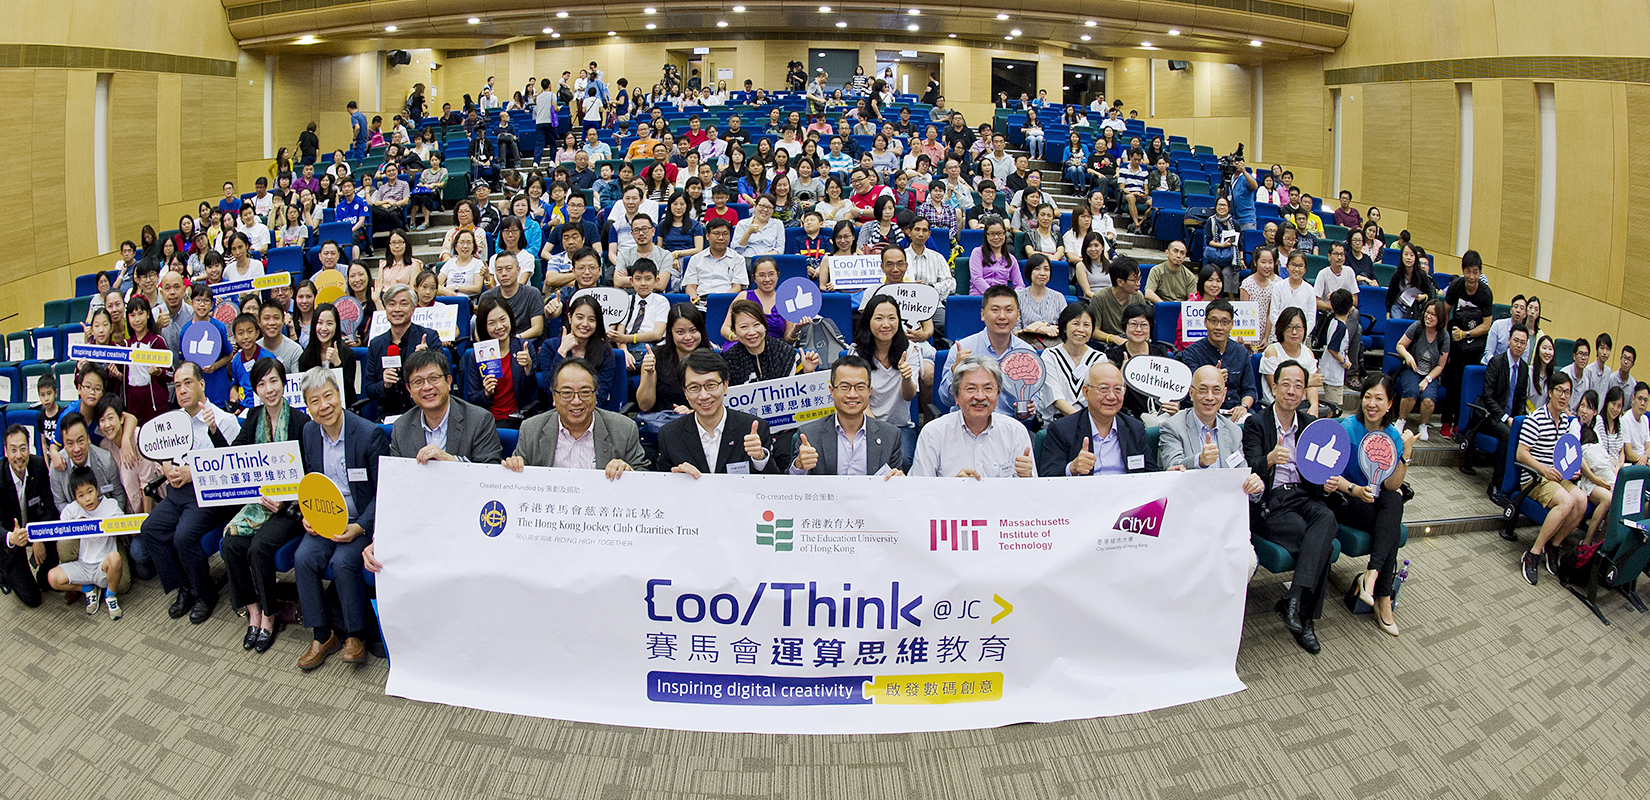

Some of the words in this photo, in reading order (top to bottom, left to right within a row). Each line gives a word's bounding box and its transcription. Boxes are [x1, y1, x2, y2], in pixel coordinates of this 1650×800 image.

[897, 286, 908, 297] im
[911, 290, 916, 298] a
[74, 348, 91, 357] Inspiring
[1150, 359, 1161, 372] im
[1164, 366, 1170, 374] a
[1130, 372, 1185, 393] coolthinker
[154, 421, 165, 433] im
[166, 421, 172, 430] a
[144, 434, 189, 452] coolthinker
[480, 482, 502, 490] Created
[537, 485, 545, 493] by
[222, 490, 236, 498] digital
[756, 492, 793, 500] Co-created
[795, 493, 803, 502] by
[519, 502, 665, 519] 香港賽馬會慈善信託基金
[1505, 508, 1512, 517] B
[517, 517, 532, 527] The
[535, 518, 557, 531] Hong
[559, 521, 581, 532] Kong
[582, 522, 610, 534] Jockey
[613, 523, 633, 533] Club
[636, 524, 674, 535] Charities
[676, 526, 699, 535] Trust
[802, 518, 865, 529] 香港教育大學
[1000, 518, 1070, 527] Massachusetts
[1119, 516, 1157, 535] CityU
[31, 528, 53, 536] Inspiring
[54, 526, 71, 534] digital
[72, 524, 97, 533] creativity
[930, 519, 987, 551] MIT
[1000, 530, 1038, 539] Institute
[1041, 530, 1050, 538] of
[554, 536, 577, 544] RIDING
[800, 534, 815, 542] The
[816, 534, 858, 543] Education
[858, 534, 899, 544] University
[810, 544, 832, 554] Hong
[834, 544, 855, 554] Kong
[999, 541, 1052, 550] Technology
[1607, 570, 1614, 580] A
[933, 600, 952, 620] @
[957, 600, 981, 619] JC
[646, 632, 1010, 668] 賽馬會運算思維教育
[657, 678, 722, 698] Inspiring
[727, 682, 776, 699] digital
[781, 683, 853, 699] creativity
[886, 680, 993, 697] 啟發數碼創意
